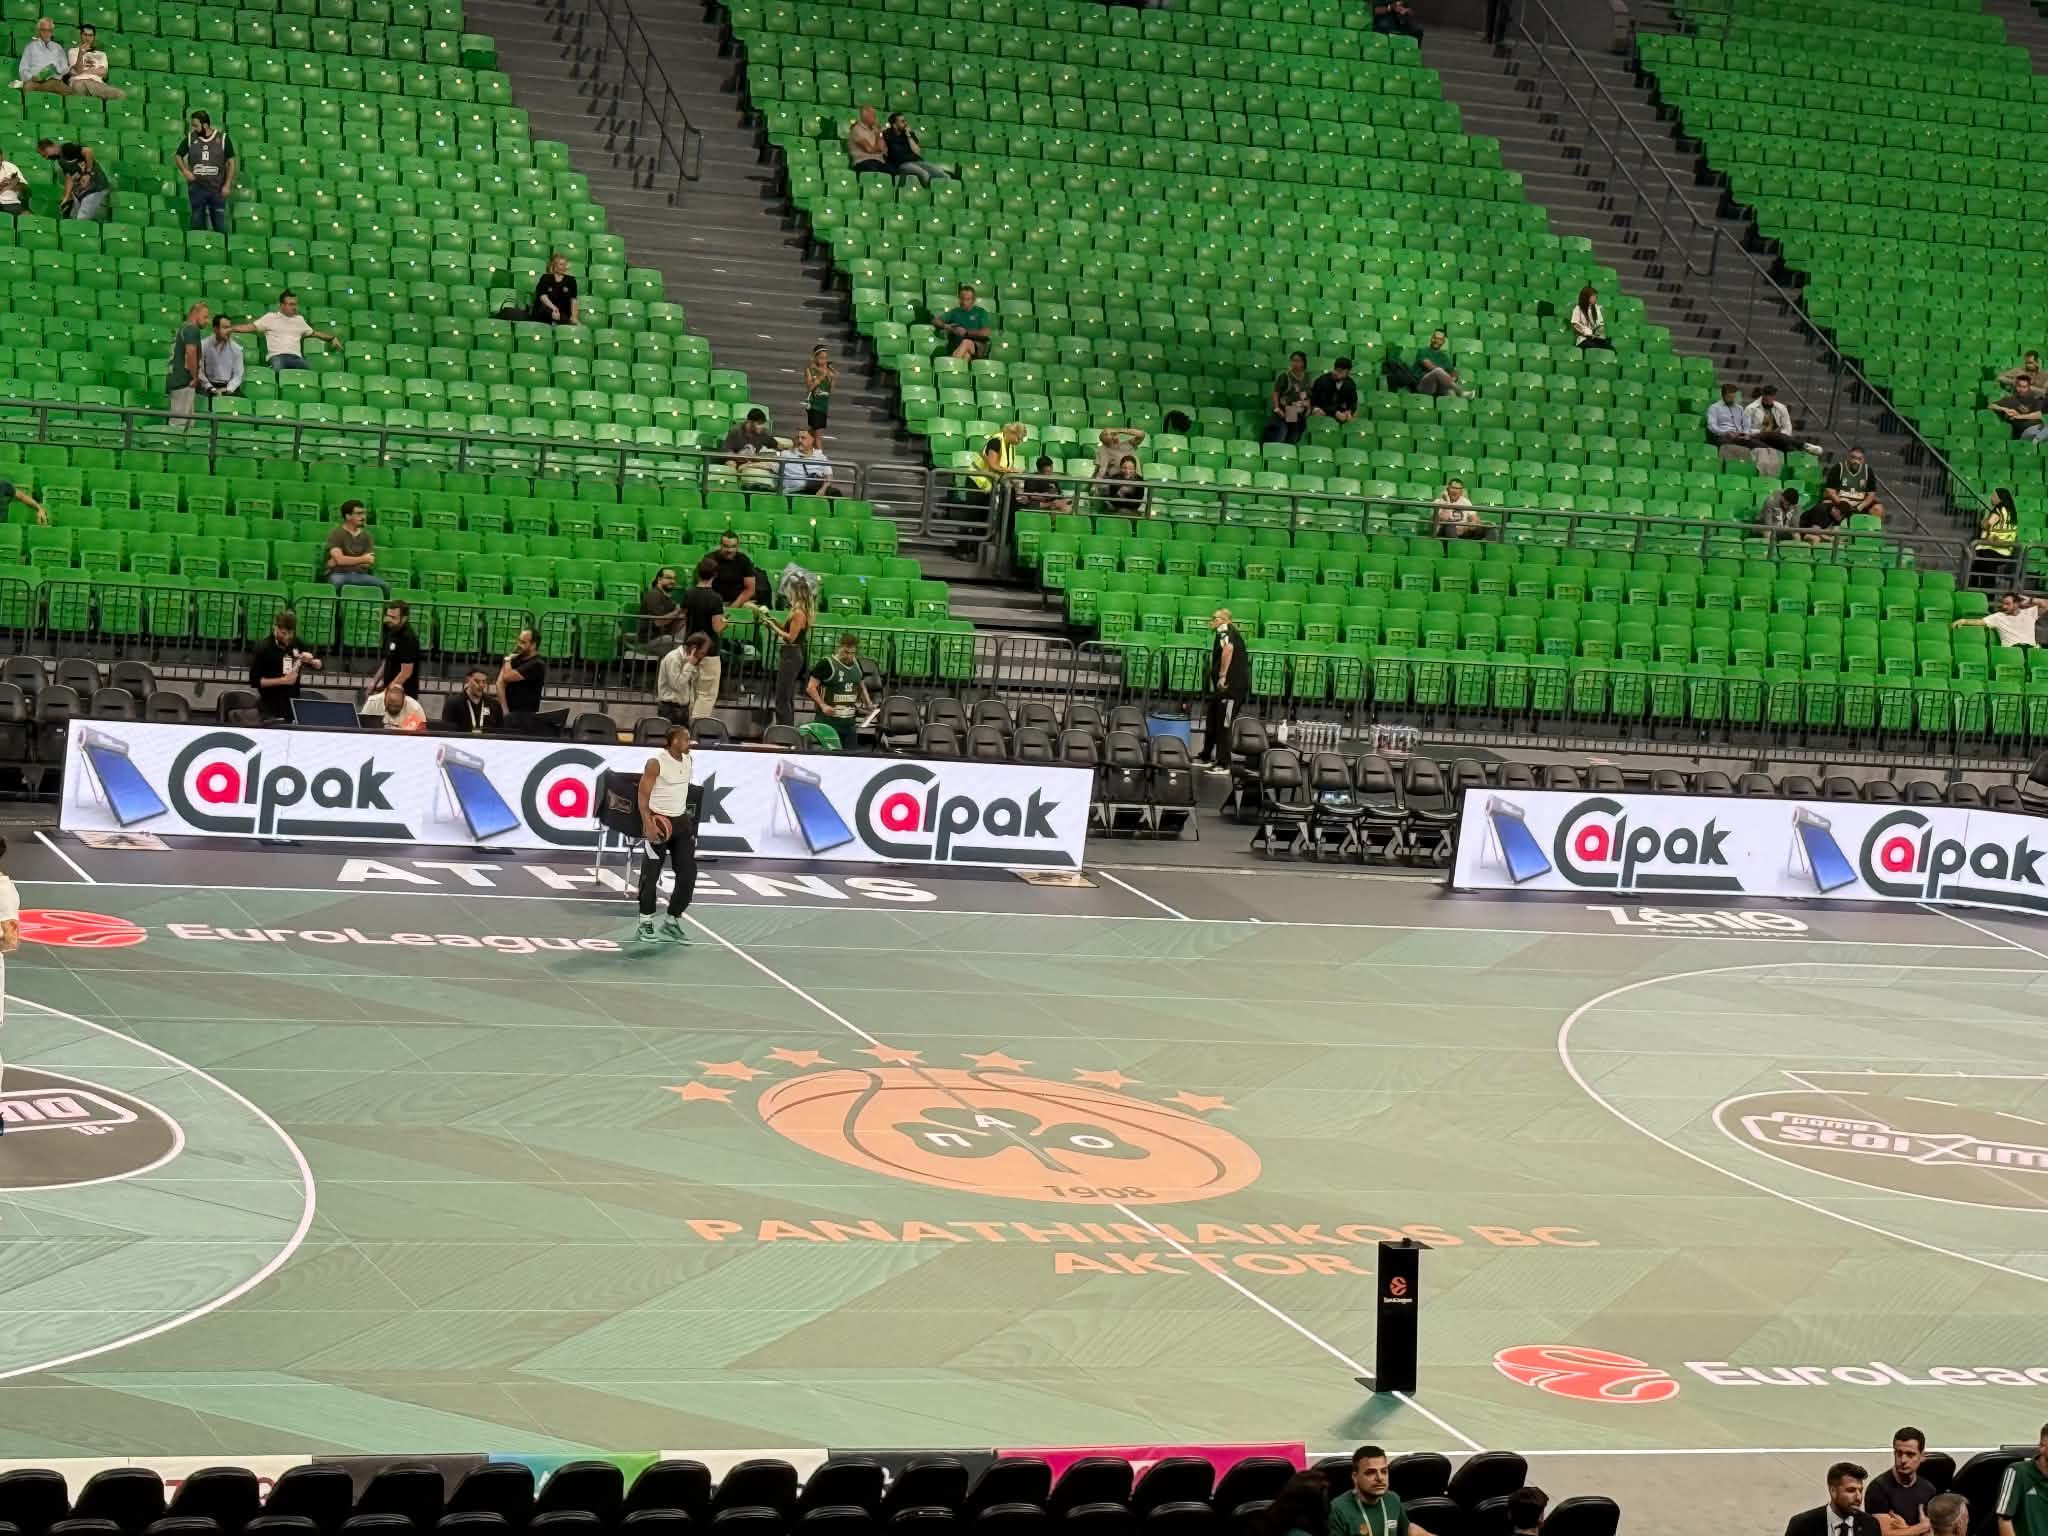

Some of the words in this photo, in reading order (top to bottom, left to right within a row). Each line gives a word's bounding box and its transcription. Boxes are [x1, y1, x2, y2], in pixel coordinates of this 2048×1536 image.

[168, 731, 415, 840] Calpak
[521, 747, 754, 853] Cak
[855, 763, 1077, 867] Calpak
[1553, 797, 1744, 891] Calpak
[1859, 809, 2048, 911] Calpak
[166, 923, 623, 954] EuroLeague
[686, 1219, 1465, 1247] PANATHINAIKOS
[1467, 1224, 1600, 1248] BC
[1042, 1184, 1157, 1199] 1908
[1055, 1251, 1376, 1276] AKTOR
